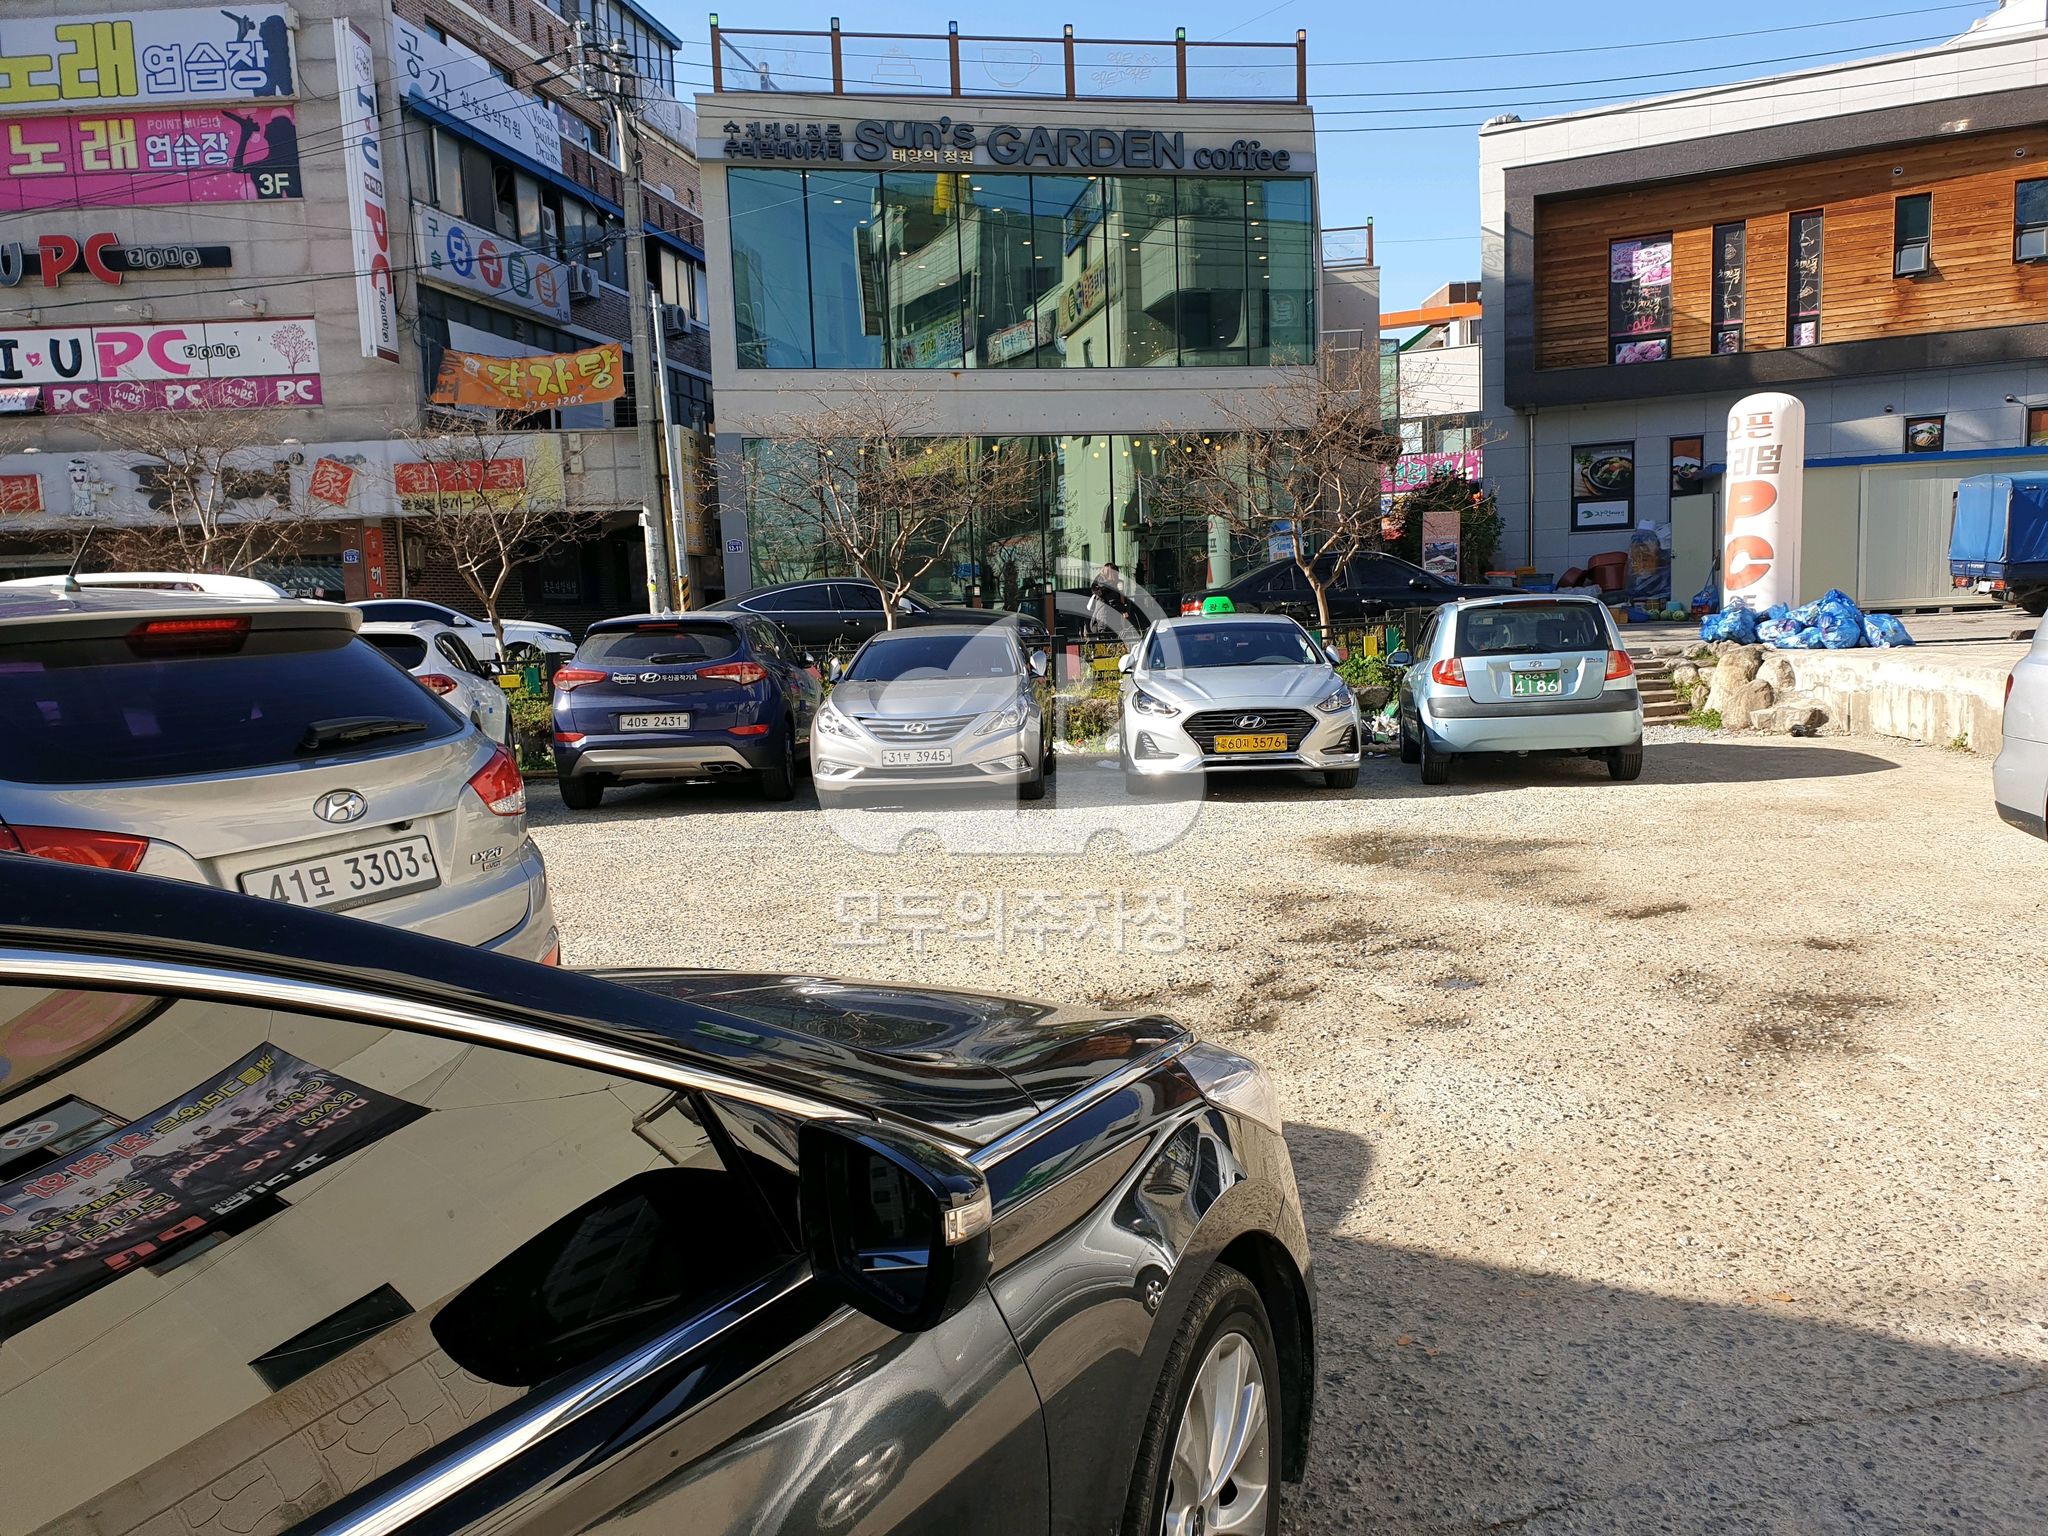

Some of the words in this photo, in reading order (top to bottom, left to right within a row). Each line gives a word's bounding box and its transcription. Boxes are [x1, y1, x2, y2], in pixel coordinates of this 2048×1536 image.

[0, 20, 138, 100] 노래
[143, 41, 268, 95] 연습장
[147, 118, 183, 131] POINT
[460, 90, 522, 141] 실용음악학원
[8, 118, 140, 176] 노래
[145, 131, 229, 168] 연습장
[533, 126, 559, 151] Guitar
[855, 116, 976, 162] Sun's
[986, 125, 1185, 170] GARDEN
[1193, 140, 1291, 172] coffee
[535, 142, 558, 165] Drum
[724, 140, 843, 161] 우리밀베이커리
[892, 150, 938, 163] 태양의
[944, 150, 973, 164] 정원
[258, 173, 290, 195] 3F
[38, 232, 125, 288] PC
[95, 329, 192, 378] PC
[183, 343, 240, 359] zone
[487, 349, 619, 399] 감자탕
[53, 388, 90, 409] PC
[165, 385, 201, 406] PC
[276, 380, 313, 402] PC
[1728, 410, 1774, 441] 오픈
[1728, 444, 1783, 477] 리덤
[661, 673, 698, 682] 두산공작기계
[1514, 679, 1558, 694] 4186
[654, 716, 682, 728] 2431
[1252, 736, 1281, 749] 3576
[888, 752, 911, 763] 31부
[916, 750, 946, 762] 3945
[269, 867, 335, 904] 41모
[344, 845, 420, 890] 3303
